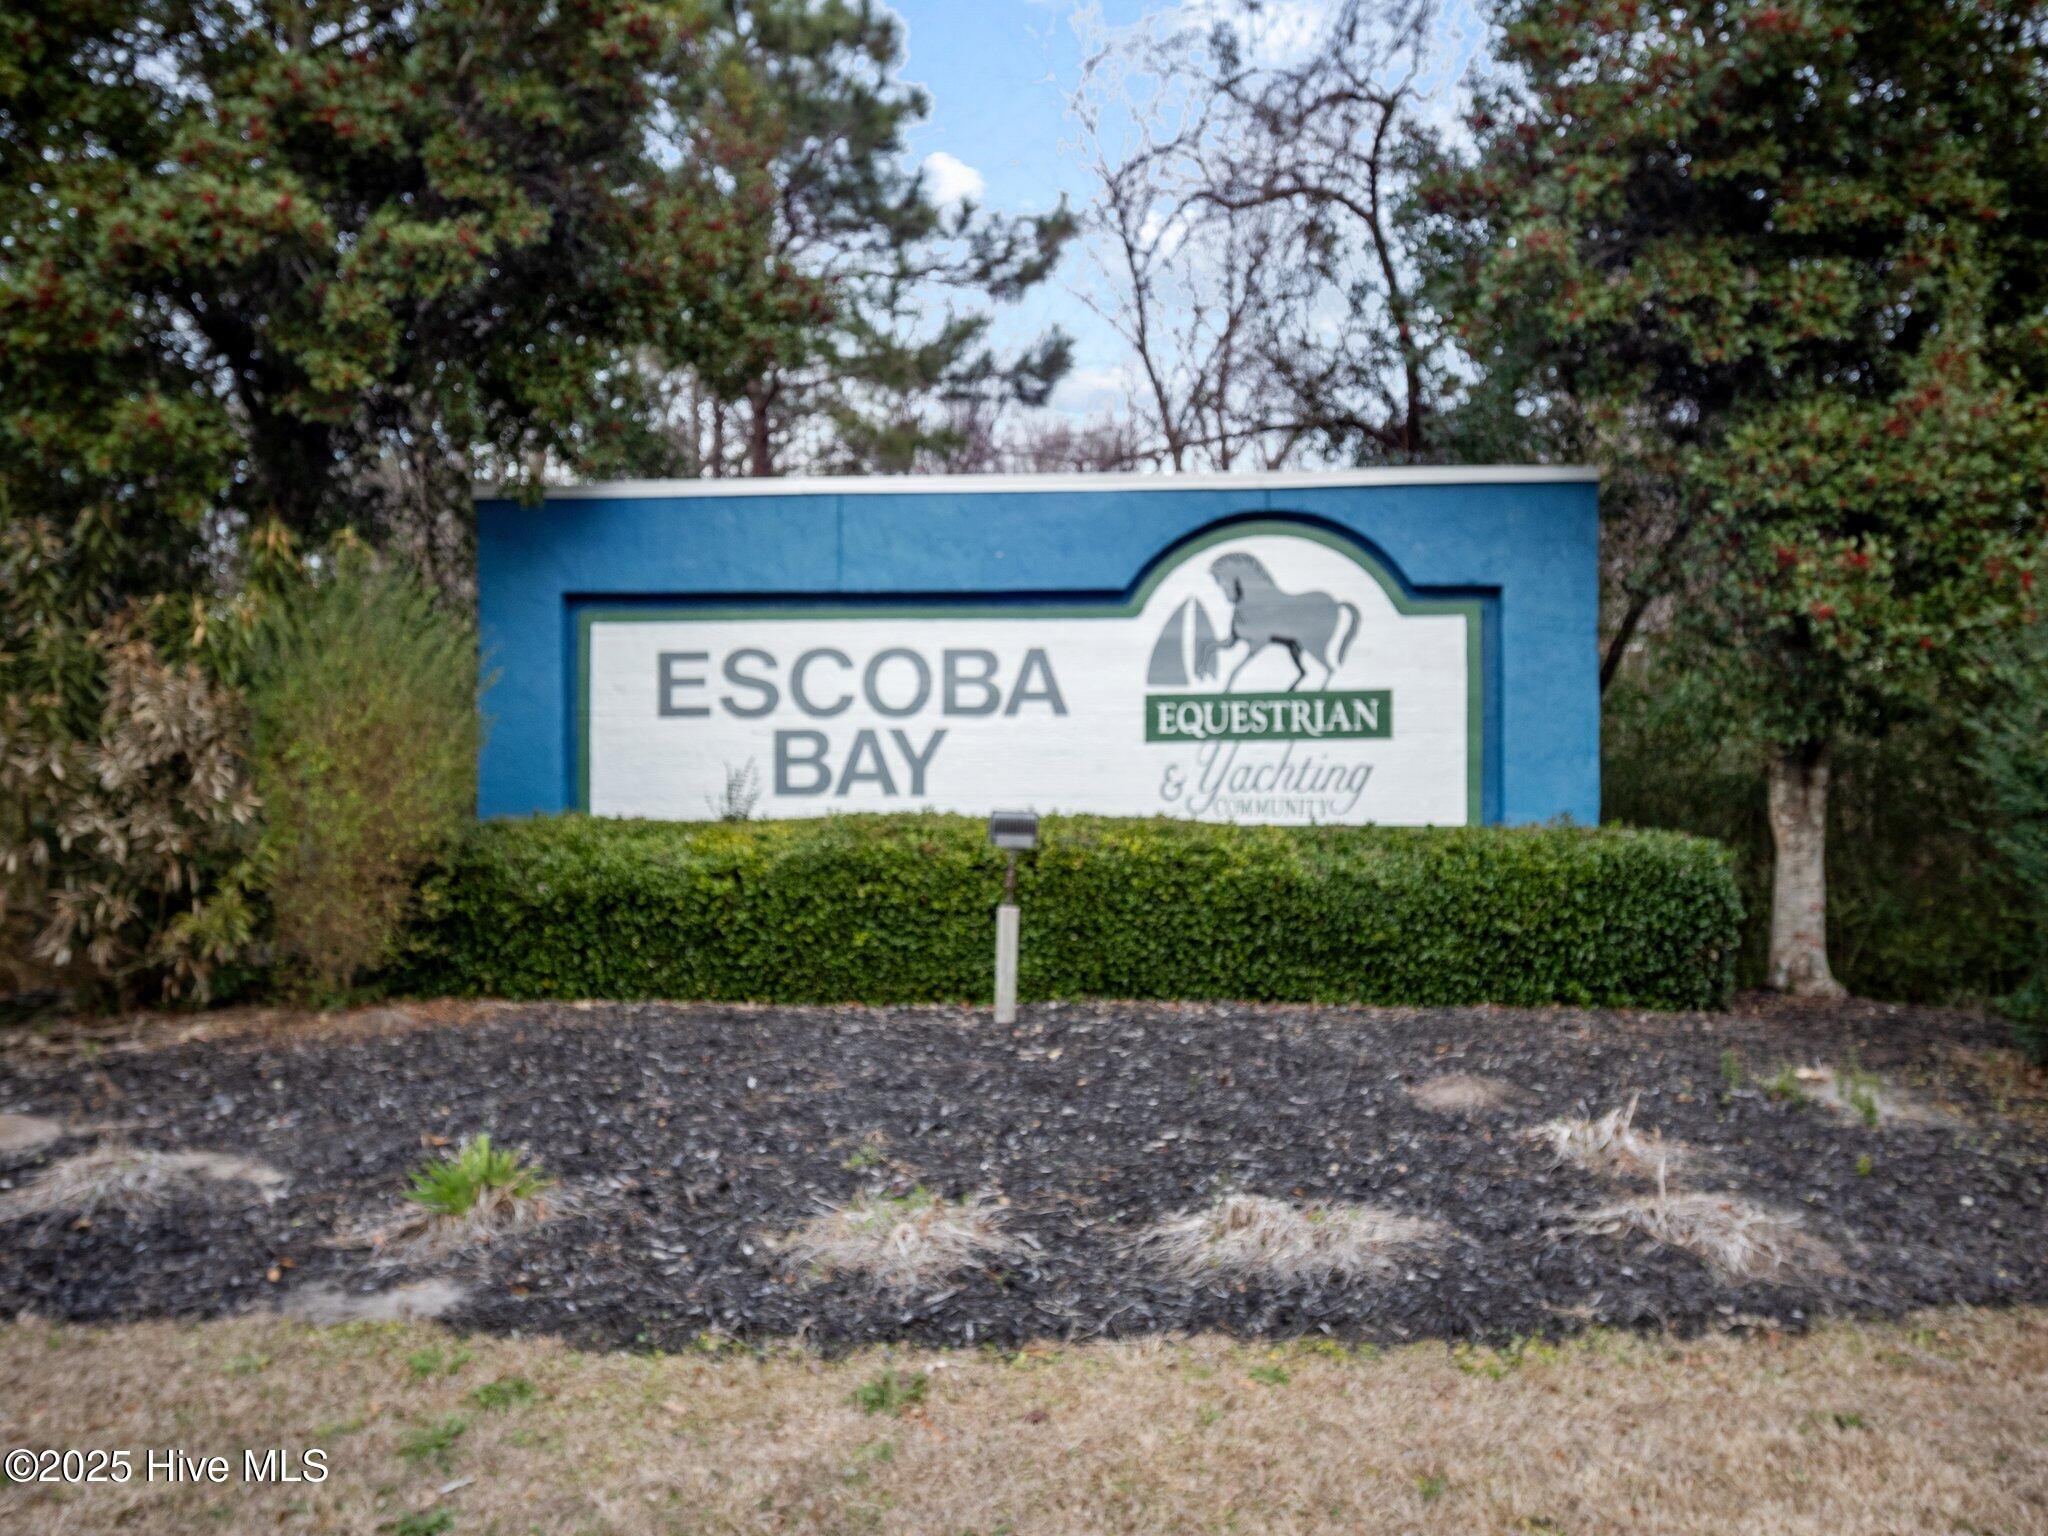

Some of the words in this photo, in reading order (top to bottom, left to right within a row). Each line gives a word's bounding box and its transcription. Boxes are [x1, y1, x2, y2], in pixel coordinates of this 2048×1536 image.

[657, 647, 1069, 718] ESCOBA
[1157, 699, 1380, 738] EQUESTRIAN
[773, 729, 948, 797] BAY
[1159, 763, 1186, 802] &
[1186, 740, 1374, 816] Yachting
[1213, 798, 1331, 818] COMMUNITY
